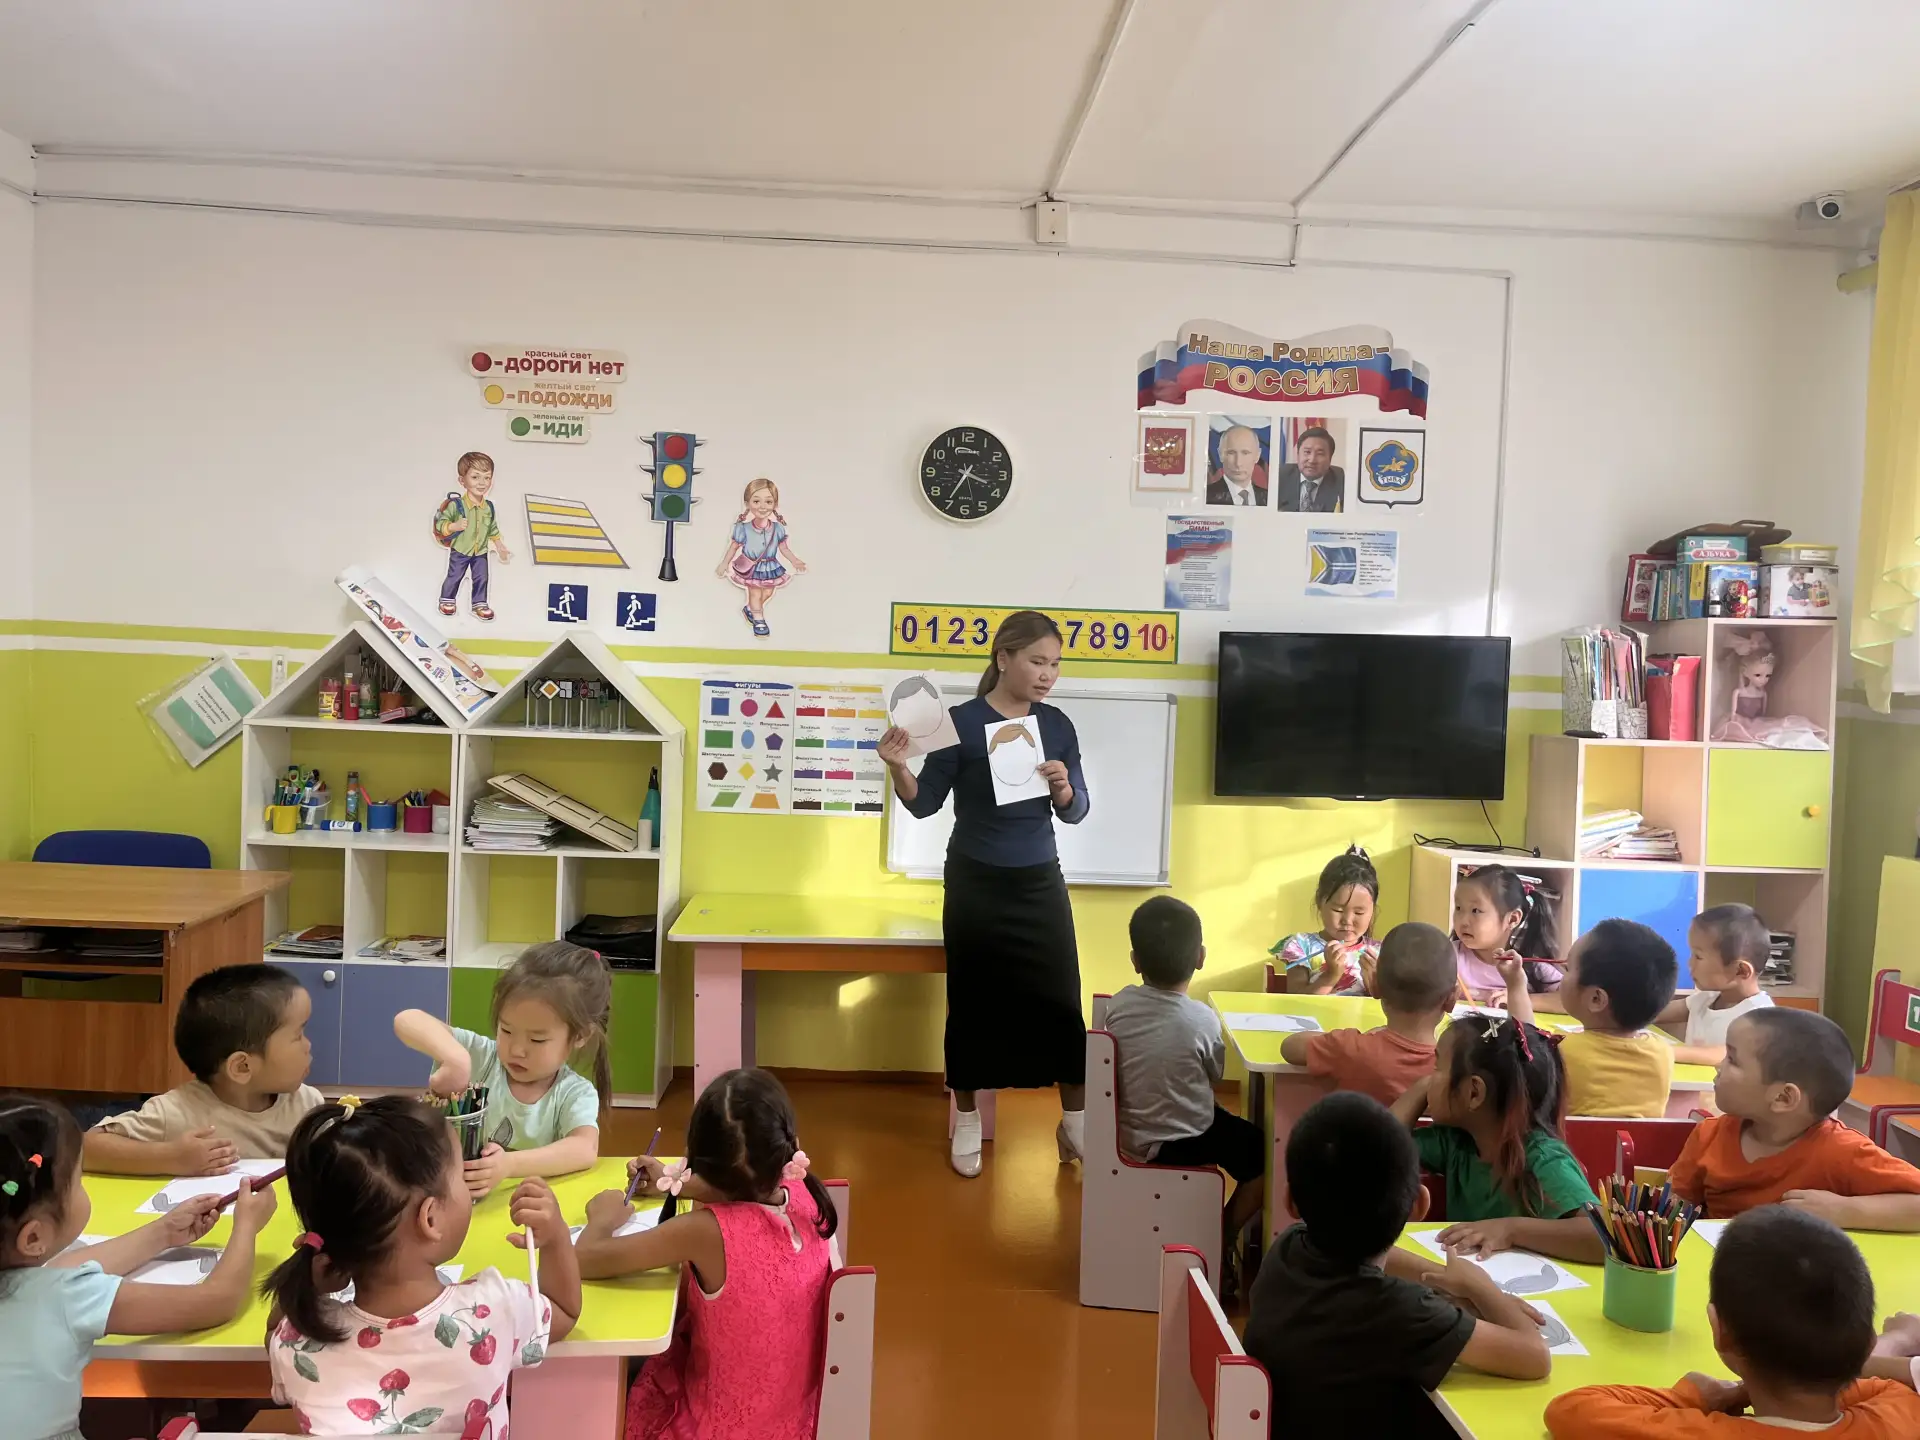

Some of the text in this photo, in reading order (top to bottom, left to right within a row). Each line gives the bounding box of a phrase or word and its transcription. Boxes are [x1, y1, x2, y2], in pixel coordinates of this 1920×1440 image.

[1187, 333, 1264, 361] Наша
[524, 350, 592, 359] красный свет
[589, 361, 625, 375] нет
[1203, 361, 1359, 396] РОССИЯ
[533, 382, 596, 391] желтый свет
[947, 437, 955, 447] 11
[961, 432, 975, 443] 12
[933, 449, 945, 459] 10
[992, 451, 1002, 462] 2
[926, 467, 936, 477] 9
[998, 470, 1007, 481] 3
[931, 486, 941, 496] 8
[991, 488, 1000, 498] 4
[945, 500, 953, 510] 7
[960, 505, 970, 515] 6
[978, 501, 987, 511] 5
[1698, 548, 1730, 558] АЗБУКА
[902, 615, 918, 643] 0
[926, 616, 938, 644] 1
[947, 617, 965, 645] 2
[972, 618, 989, 646] 3
[1066, 620, 1083, 648] 7
[1089, 622, 1106, 650] 8
[1113, 622, 1130, 650] 9
[1137, 623, 1167, 651] 10
